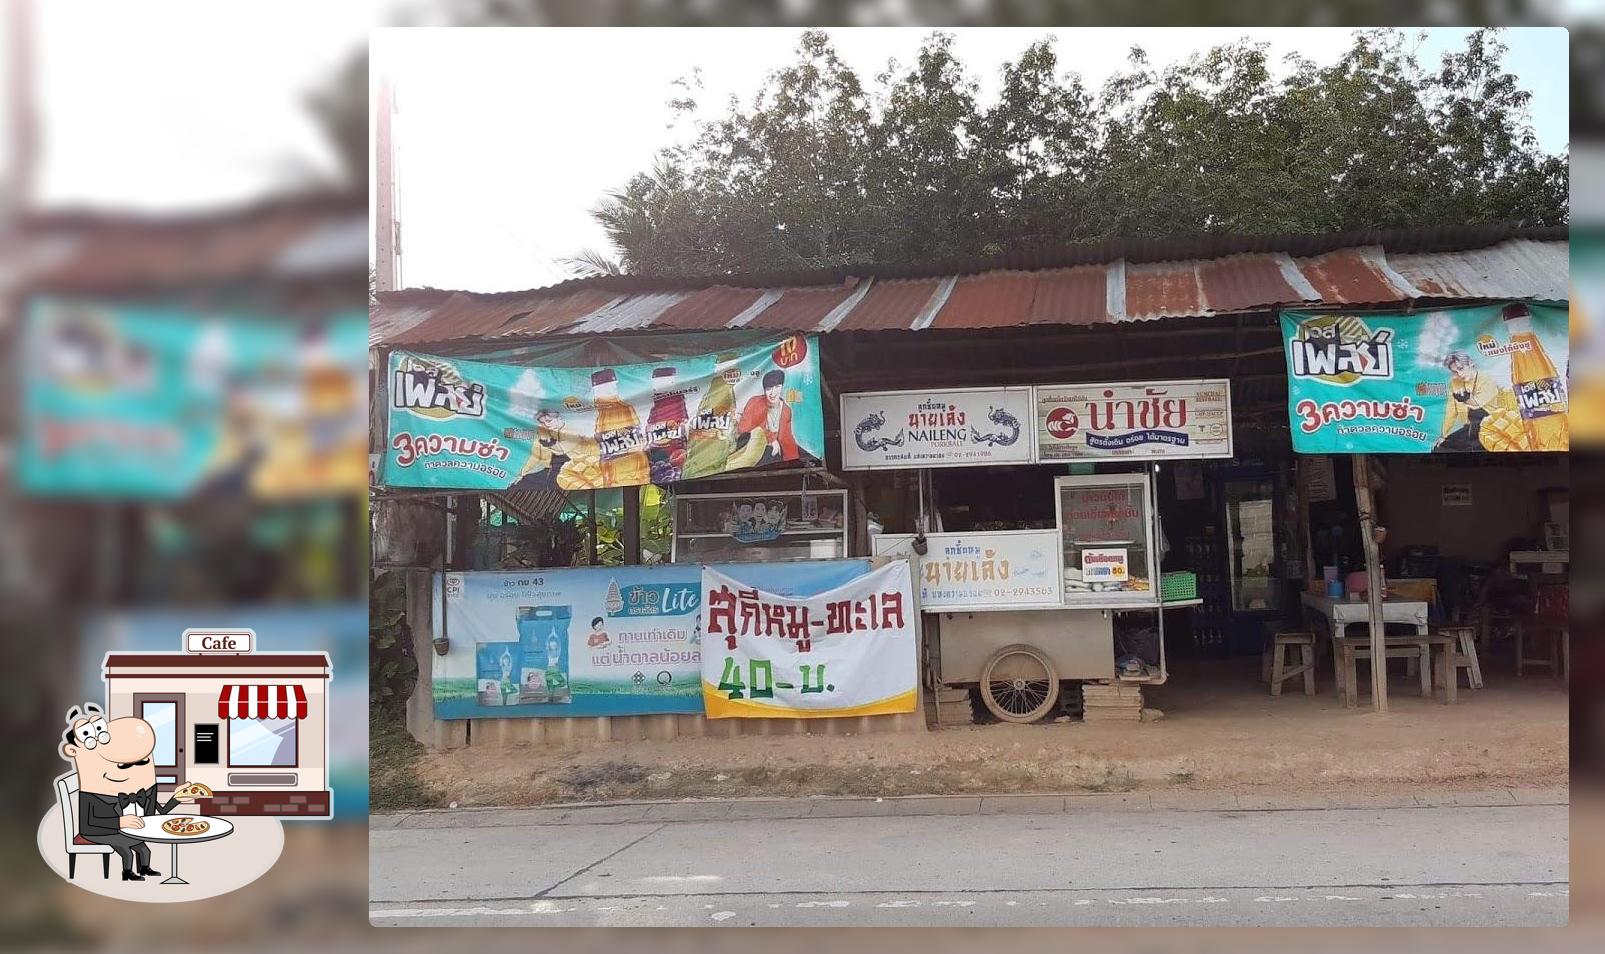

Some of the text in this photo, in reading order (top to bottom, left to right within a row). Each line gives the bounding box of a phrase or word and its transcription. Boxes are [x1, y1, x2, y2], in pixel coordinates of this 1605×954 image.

[1297, 398, 1424, 432] 3ความซ่า
[908, 428, 967, 442] NAILENG
[393, 433, 509, 465] 3ความซ่า
[518, 579, 530, 587] กข
[533, 577, 544, 587] 43
[629, 586, 700, 613] ข้าว Lite
